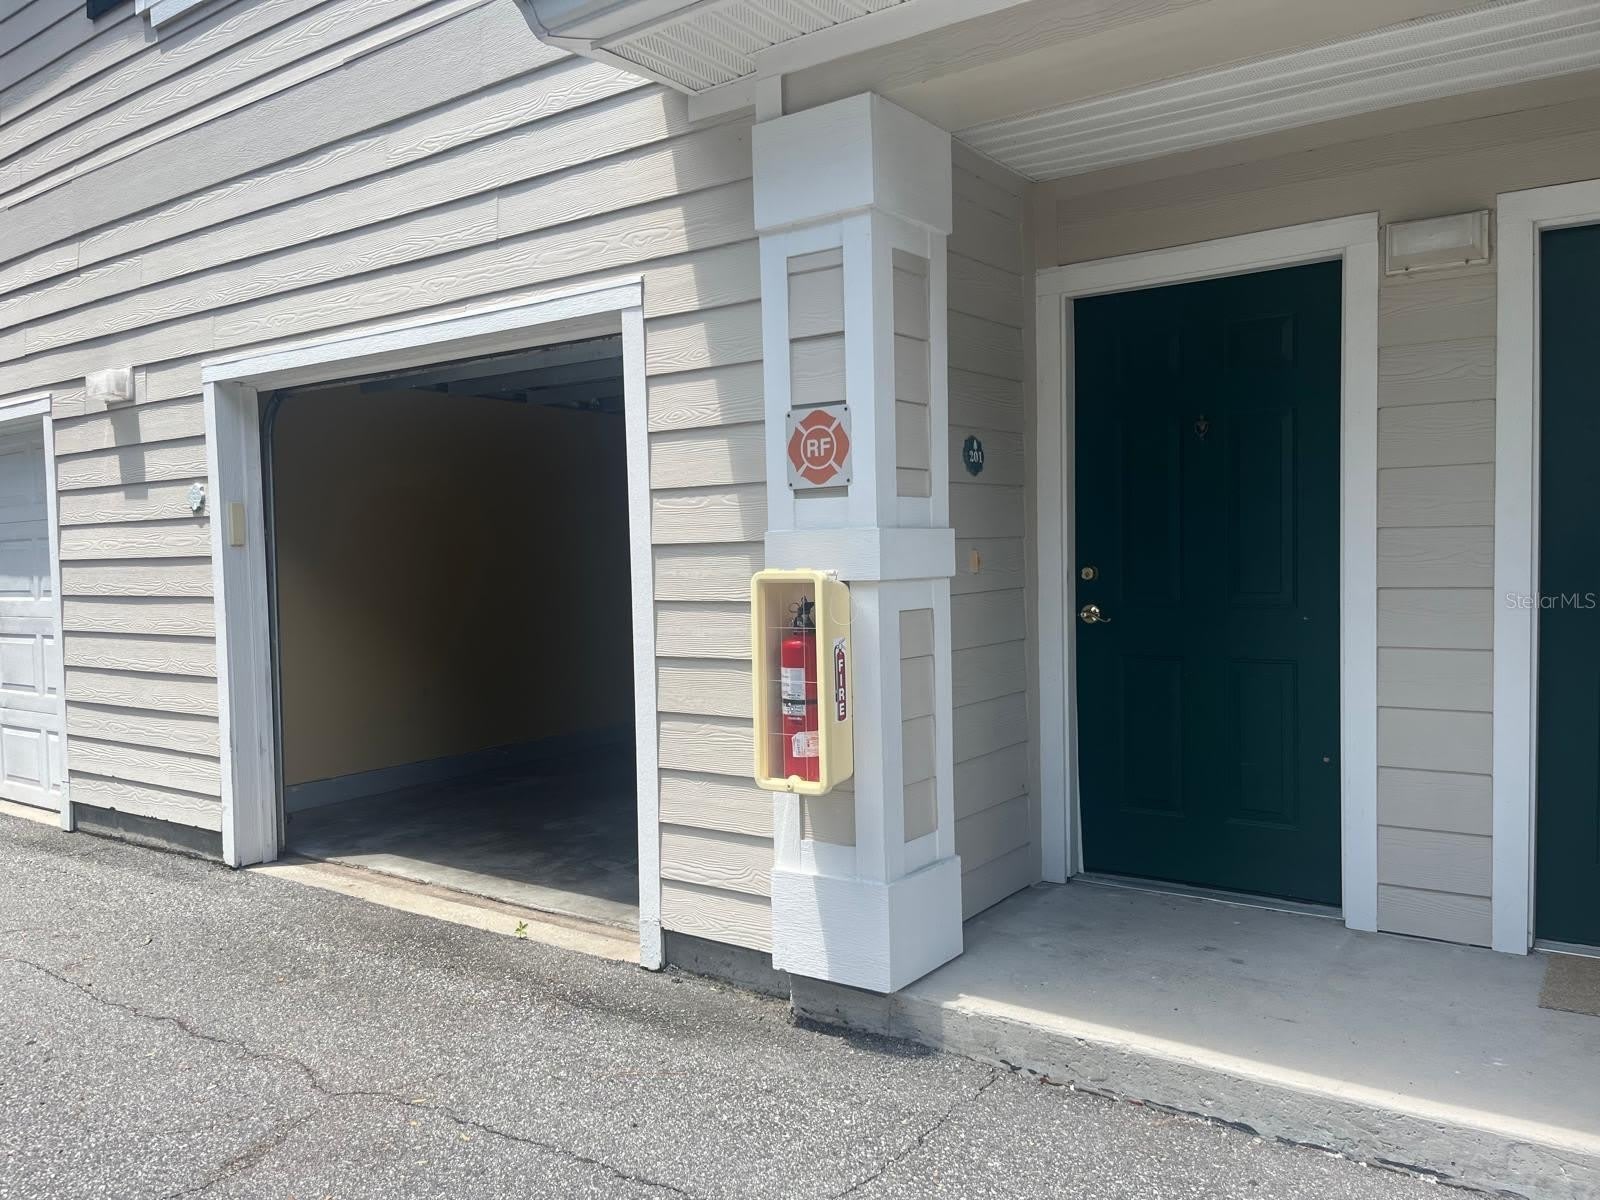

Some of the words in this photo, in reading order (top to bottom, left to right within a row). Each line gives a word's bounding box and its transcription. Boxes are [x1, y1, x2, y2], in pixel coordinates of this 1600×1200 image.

[807, 438, 831, 457] RF
[969, 450, 982, 463] 201
[837, 659, 846, 716] FIRE
